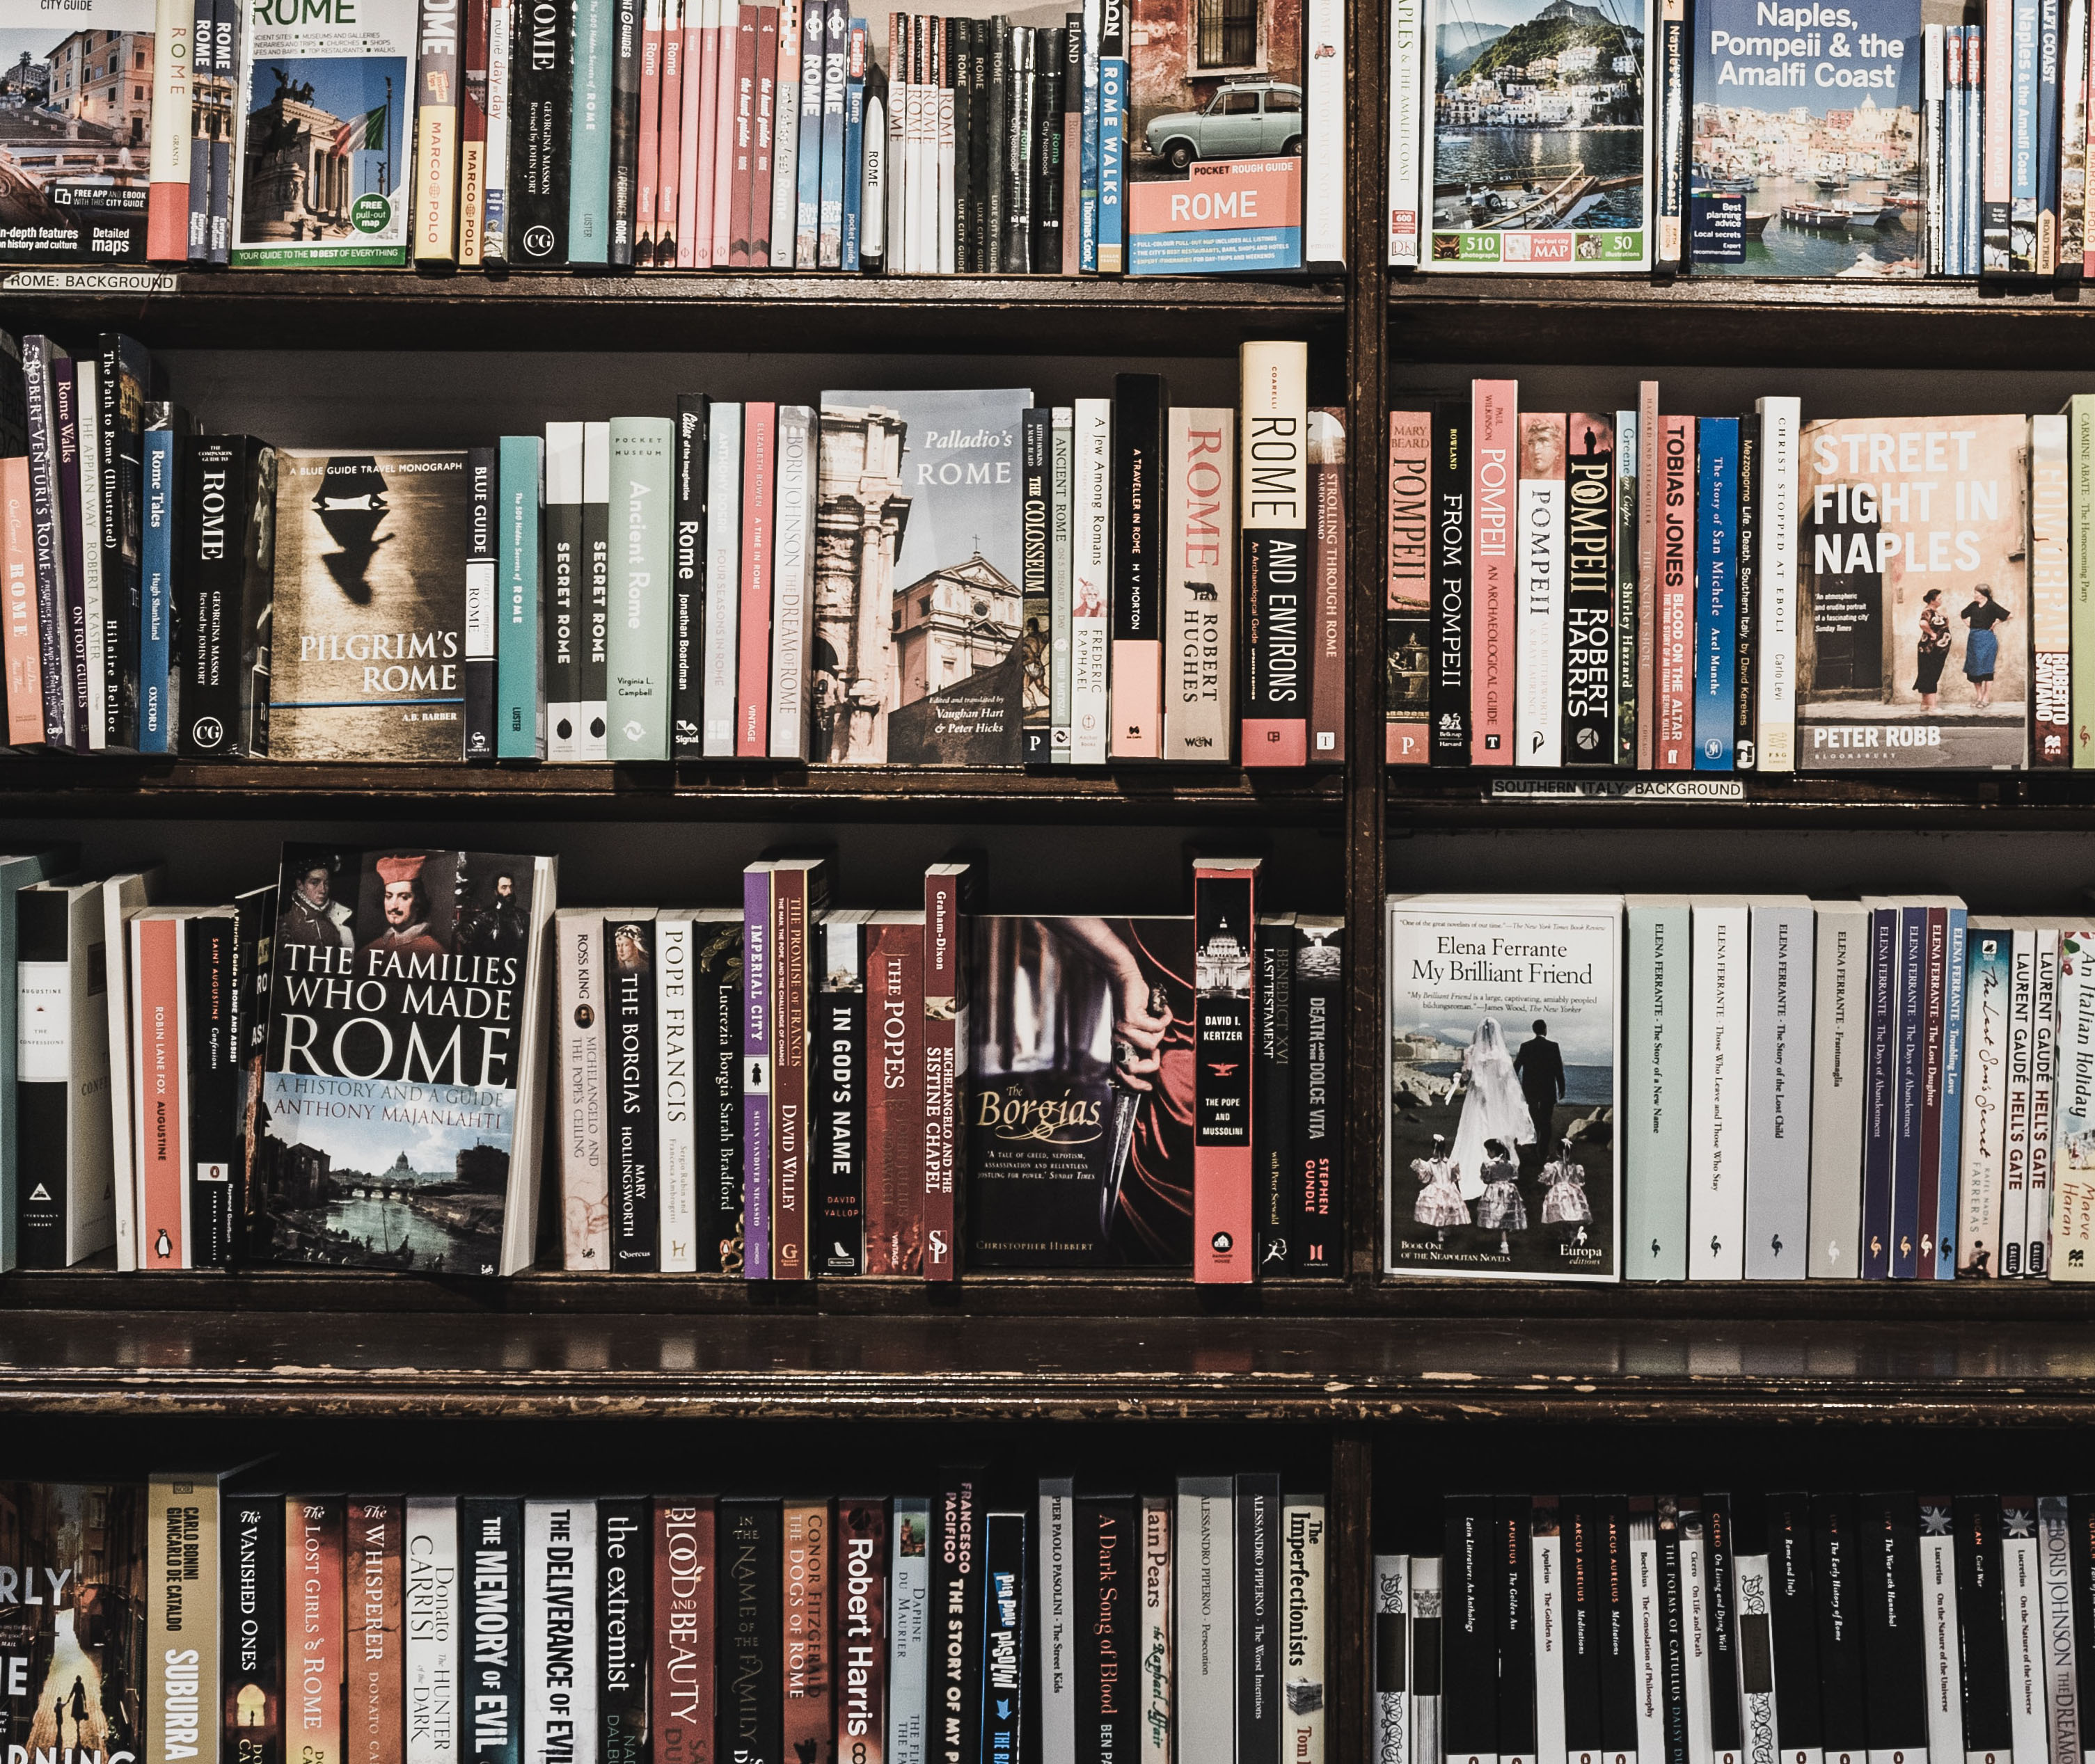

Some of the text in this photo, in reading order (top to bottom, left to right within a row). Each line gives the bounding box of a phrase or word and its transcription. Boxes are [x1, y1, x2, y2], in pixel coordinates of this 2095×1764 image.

[1757, 1, 1858, 30] Naples,
[171, 28, 186, 95] ROME
[667, 42, 679, 76] Rome
[1711, 31, 1904, 63] Pompeii & the
[824, 53, 843, 115] ROME
[1718, 60, 1895, 88] Amalfi Coast
[1102, 67, 1118, 205] ROME WALKS
[428, 122, 441, 243] MARCO POLO
[868, 151, 878, 187] ROME
[1194, 162, 1294, 177] POCKET ROUGH GUIDE
[74, 189, 90, 198] FREE
[122, 191, 146, 199] EBOOK
[91, 198, 104, 207] THIS
[122, 199, 144, 207] GUIDE
[356, 211, 386, 220] pull-out
[360, 201, 382, 209] FREE
[1171, 191, 1257, 221] ROME
[1705, 211, 1741, 221] planning
[1723, 203, 1741, 212] Best
[93, 228, 129, 239] Detailed
[361, 218, 379, 228] map
[1714, 218, 1741, 228] advice
[92, 240, 129, 255] maps
[239, 251, 260, 259] YOUR
[262, 251, 282, 259] GUIDE
[351, 248, 398, 257] EVERYTHING
[10, 275, 173, 288] ROME: BACKGROUND
[924, 431, 1013, 451] Palladio's
[1392, 437, 1430, 449] BEARD
[1393, 426, 1427, 437] MARY
[1813, 429, 1977, 475] STREET
[150, 450, 164, 528] Rome Tales
[300, 467, 323, 475] BLUE
[327, 466, 357, 474] GUIDE
[361, 465, 395, 474] TRAVEL
[397, 463, 462, 472] MONOGRAPH
[917, 461, 1012, 486] ROME
[1251, 418, 1297, 520] ROME
[201, 470, 226, 560] ROME
[1185, 427, 1222, 569] ROME
[1392, 457, 1427, 580] POMPEII
[1480, 448, 1507, 557] POMPEII
[1665, 426, 1684, 587] TOBIAS JONES
[1815, 480, 1998, 525] FIGHT IN
[679, 521, 699, 580] Rome
[1025, 477, 1045, 592] THE COLOSSEUM
[1570, 462, 1608, 593] POMPEII
[1531, 490, 1551, 615] POMPEII
[1815, 530, 1981, 574] NAPLES
[558, 543, 569, 664] SECRET ROME
[1442, 493, 1462, 688] FROM POMPEII
[679, 594, 690, 690] Jonathan Boardman
[1268, 539, 1296, 703] AND ENVIRONS
[300, 631, 457, 660] PILGRIM'S
[1183, 610, 1199, 703] HUGHES
[1201, 614, 1218, 702] ROBERT
[1567, 607, 1588, 717] HARRIS
[1588, 609, 1608, 717] ROBERT
[107, 620, 118, 733] Hilaire Belloc
[362, 665, 457, 693] ROME
[617, 677, 643, 686] Virginia
[618, 688, 652, 697] Campbell
[148, 686, 157, 732] OXFORD
[1815, 726, 1940, 749] PETER ROBB
[1495, 781, 1740, 796] SOUTHERN ITALY: BACKGROUND
[936, 891, 947, 970] Graham-Dixon
[1437, 937, 1567, 958] Elena Ferrante
[285, 944, 518, 987] THE FAMILIES
[1412, 960, 1592, 985] My Brilliant Friend
[285, 976, 512, 1022] WHO MADE
[1205, 1016, 1241, 1026] DAVID I.
[622, 974, 640, 1115] THE BORGIAS
[665, 930, 686, 1123] POPE FRANCIS
[884, 959, 904, 1090] THE POPES
[1203, 1031, 1242, 1041] KERTZER
[280, 1012, 512, 1089] ROME
[155, 1006, 166, 1161] ROBIN LANE FOX AUGUSTINE
[832, 1008, 852, 1175] IN GOD'S NAME
[1205, 1098, 1240, 1106] THE POPE
[274, 1099, 502, 1129] ANTHONY MAJANLAHTI
[925, 1047, 941, 1194] SISTINE CHAPEL
[1203, 1127, 1243, 1136] MUSSOLINI
[622, 1126, 634, 1237] HOLLINGSWORTH
[635, 1164, 645, 1199] MARY
[1305, 1159, 1315, 1212] GUNDLE
[1318, 1159, 1328, 1214] STEPHEN
[1560, 1244, 1602, 1259] Europa
[1309, 1520, 1322, 1544] The
[240, 1527, 258, 1671] VANISHED ONES
[608, 1517, 638, 1692] the extremist
[1290, 1512, 1311, 1667] Imperfectionists
[2047, 1525, 2071, 1666] BORIS JOHNSON
[475, 1517, 508, 1753] THE MEMORY OF EVIL
[848, 1539, 873, 1736] Robert Harris
[1093, 1515, 1118, 1715] A Dark Song of Blood
[166, 1649, 199, 1761] SUBURRA
